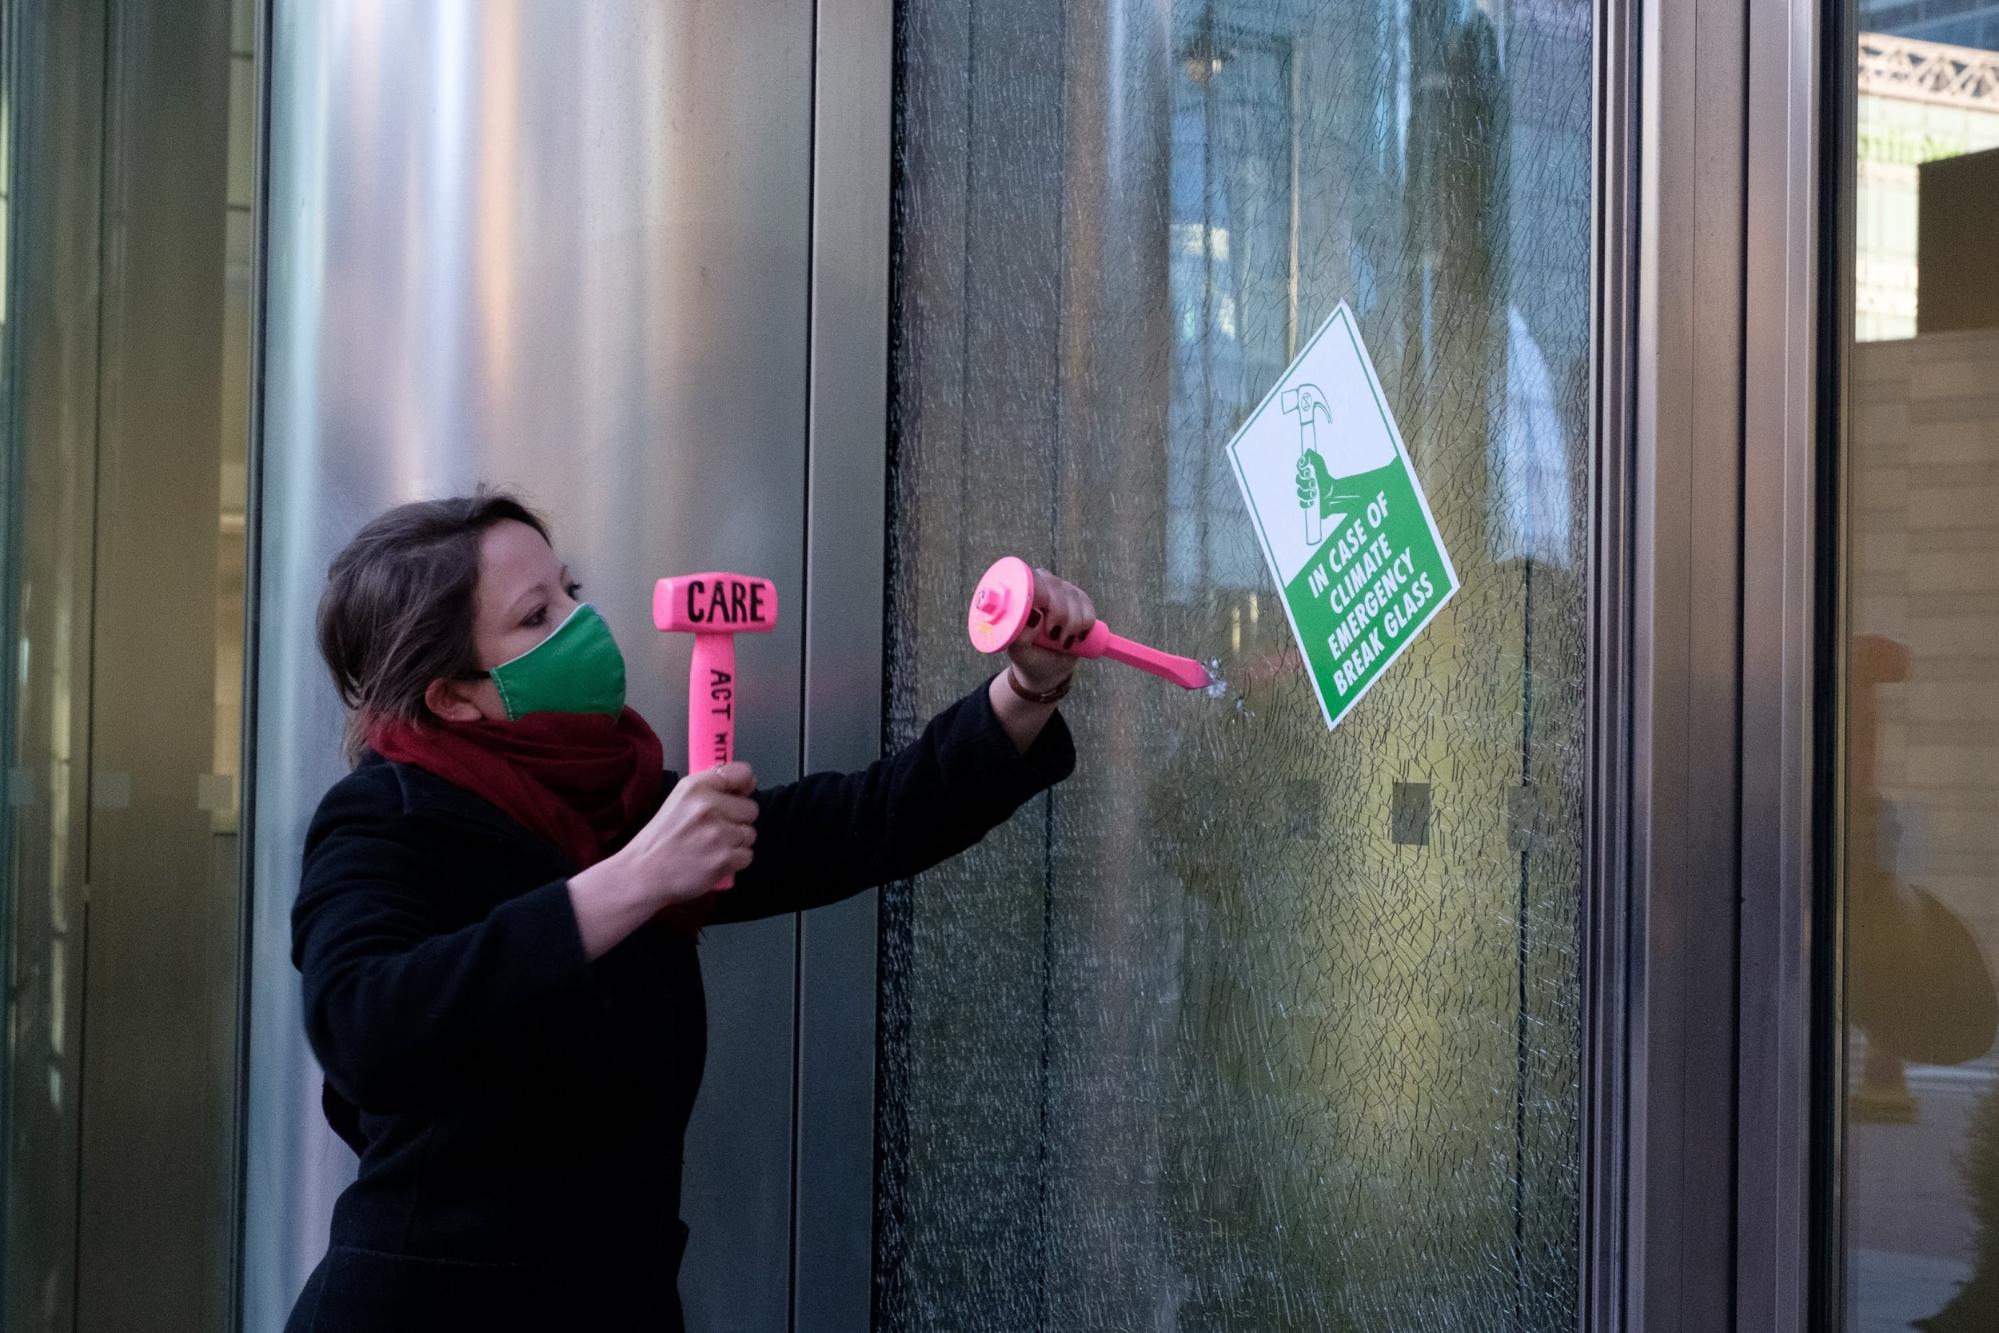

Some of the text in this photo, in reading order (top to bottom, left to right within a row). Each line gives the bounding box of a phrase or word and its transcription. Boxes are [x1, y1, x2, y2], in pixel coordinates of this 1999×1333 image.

[1307, 490, 1389, 598] IN CASE OF
[1330, 532, 1393, 614] CLIMATE
[687, 580, 766, 623] CARE
[1327, 547, 1415, 661] EMERGENCY
[1333, 571, 1434, 697] BREAK GLASS
[710, 669, 732, 768] ACT WIT
